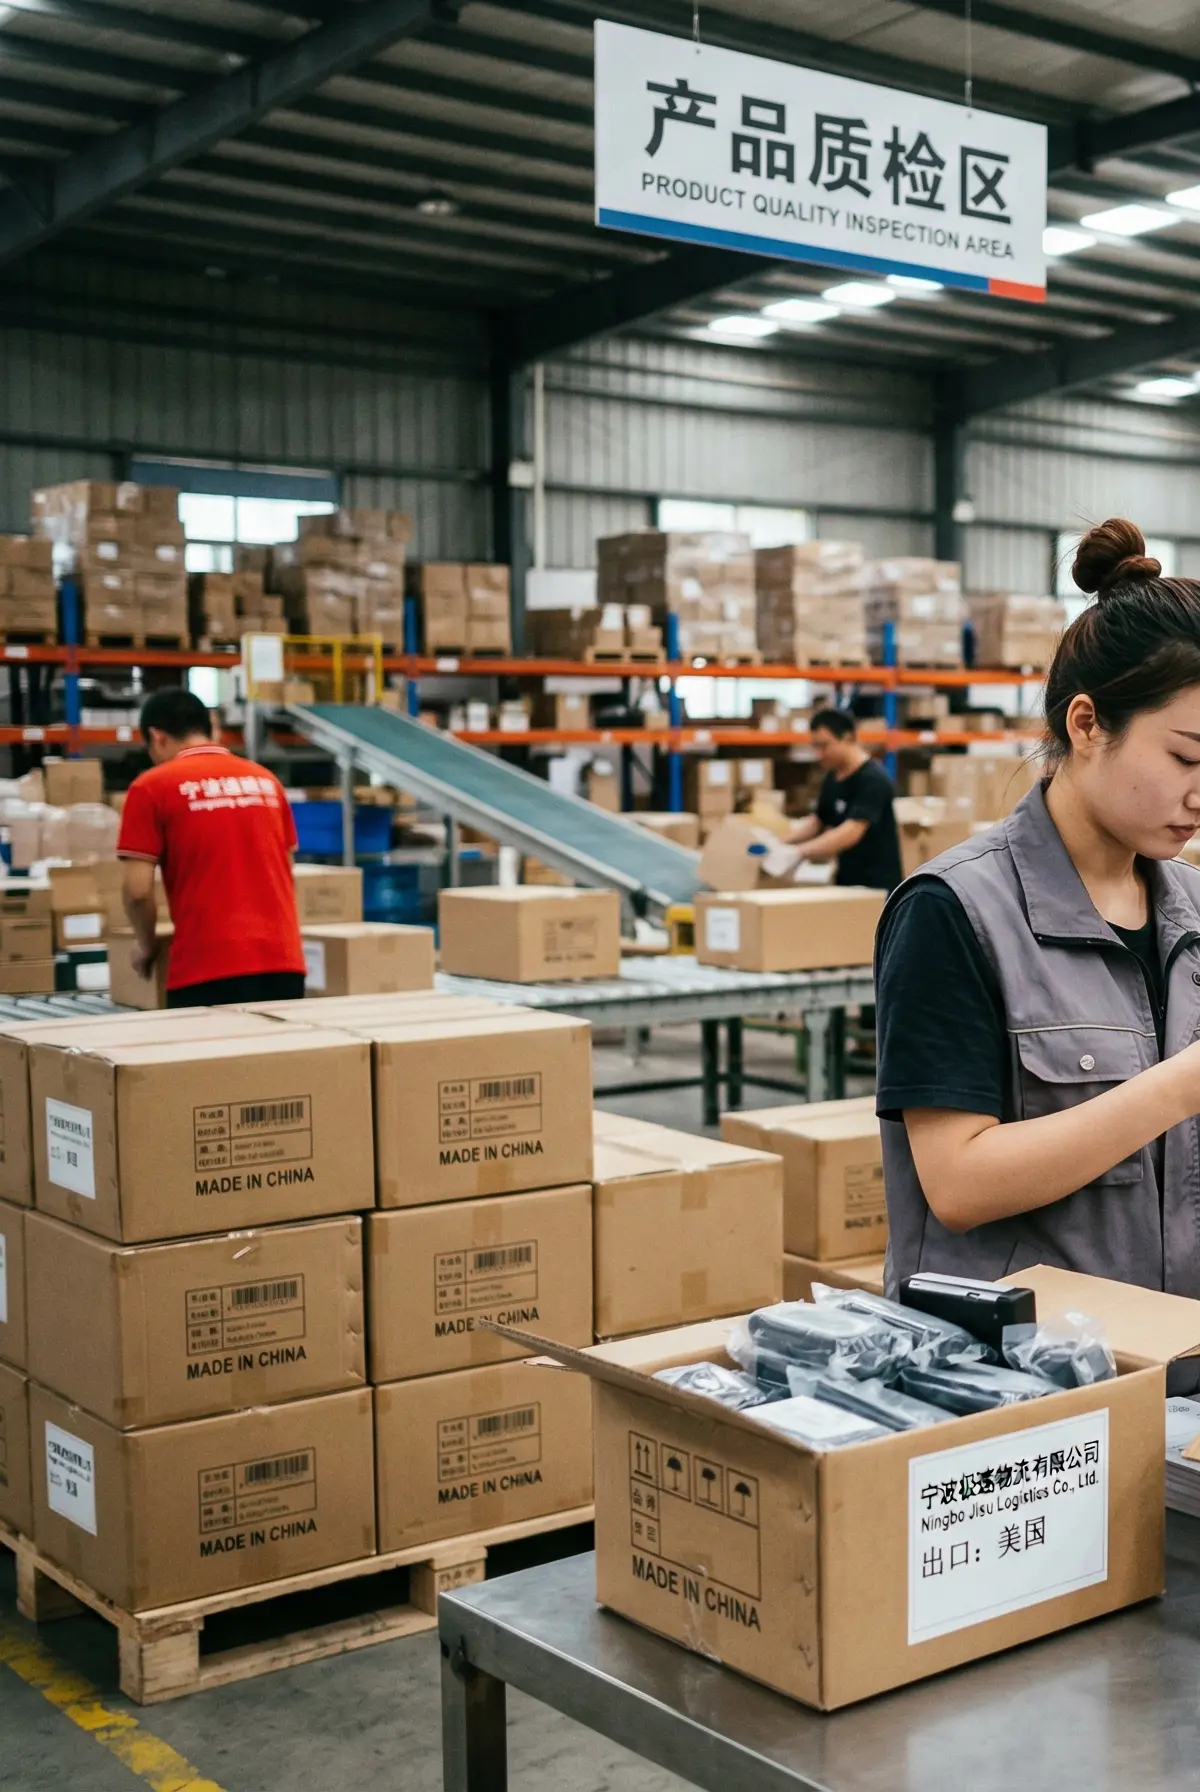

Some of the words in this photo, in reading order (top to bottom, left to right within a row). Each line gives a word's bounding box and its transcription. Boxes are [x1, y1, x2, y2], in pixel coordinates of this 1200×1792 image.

[645, 78, 1012, 224] 产品质检区
[642, 172, 746, 208] PRODUCT
[753, 194, 840, 227] QUALITY
[846, 212, 960, 249] INSPECTION
[965, 235, 1014, 259] AREA
[439, 1147, 480, 1165] MADE
[484, 1146, 498, 1160] IN
[501, 1140, 544, 1158] CHINA
[195, 1175, 242, 1197] MADE
[247, 1172, 262, 1190] IN
[267, 1166, 315, 1188] CHINA
[435, 1317, 474, 1337] MADE
[497, 1307, 539, 1325] CHINA
[187, 1357, 233, 1380] MADE
[238, 1354, 253, 1371] IN
[258, 1345, 307, 1367] CHINA
[438, 1482, 479, 1504] MADE
[482, 1479, 496, 1494] IN
[500, 1469, 542, 1491] CHINA
[921, 1510, 965, 1534] Ningbo
[969, 1502, 994, 1520] Jisu
[200, 1533, 246, 1557] MADE
[250, 1529, 265, 1547] IN
[269, 1517, 318, 1541] CHINA
[632, 1555, 679, 1596] MADE
[683, 1576, 699, 1604] IN
[705, 1587, 761, 1632] CHINA
